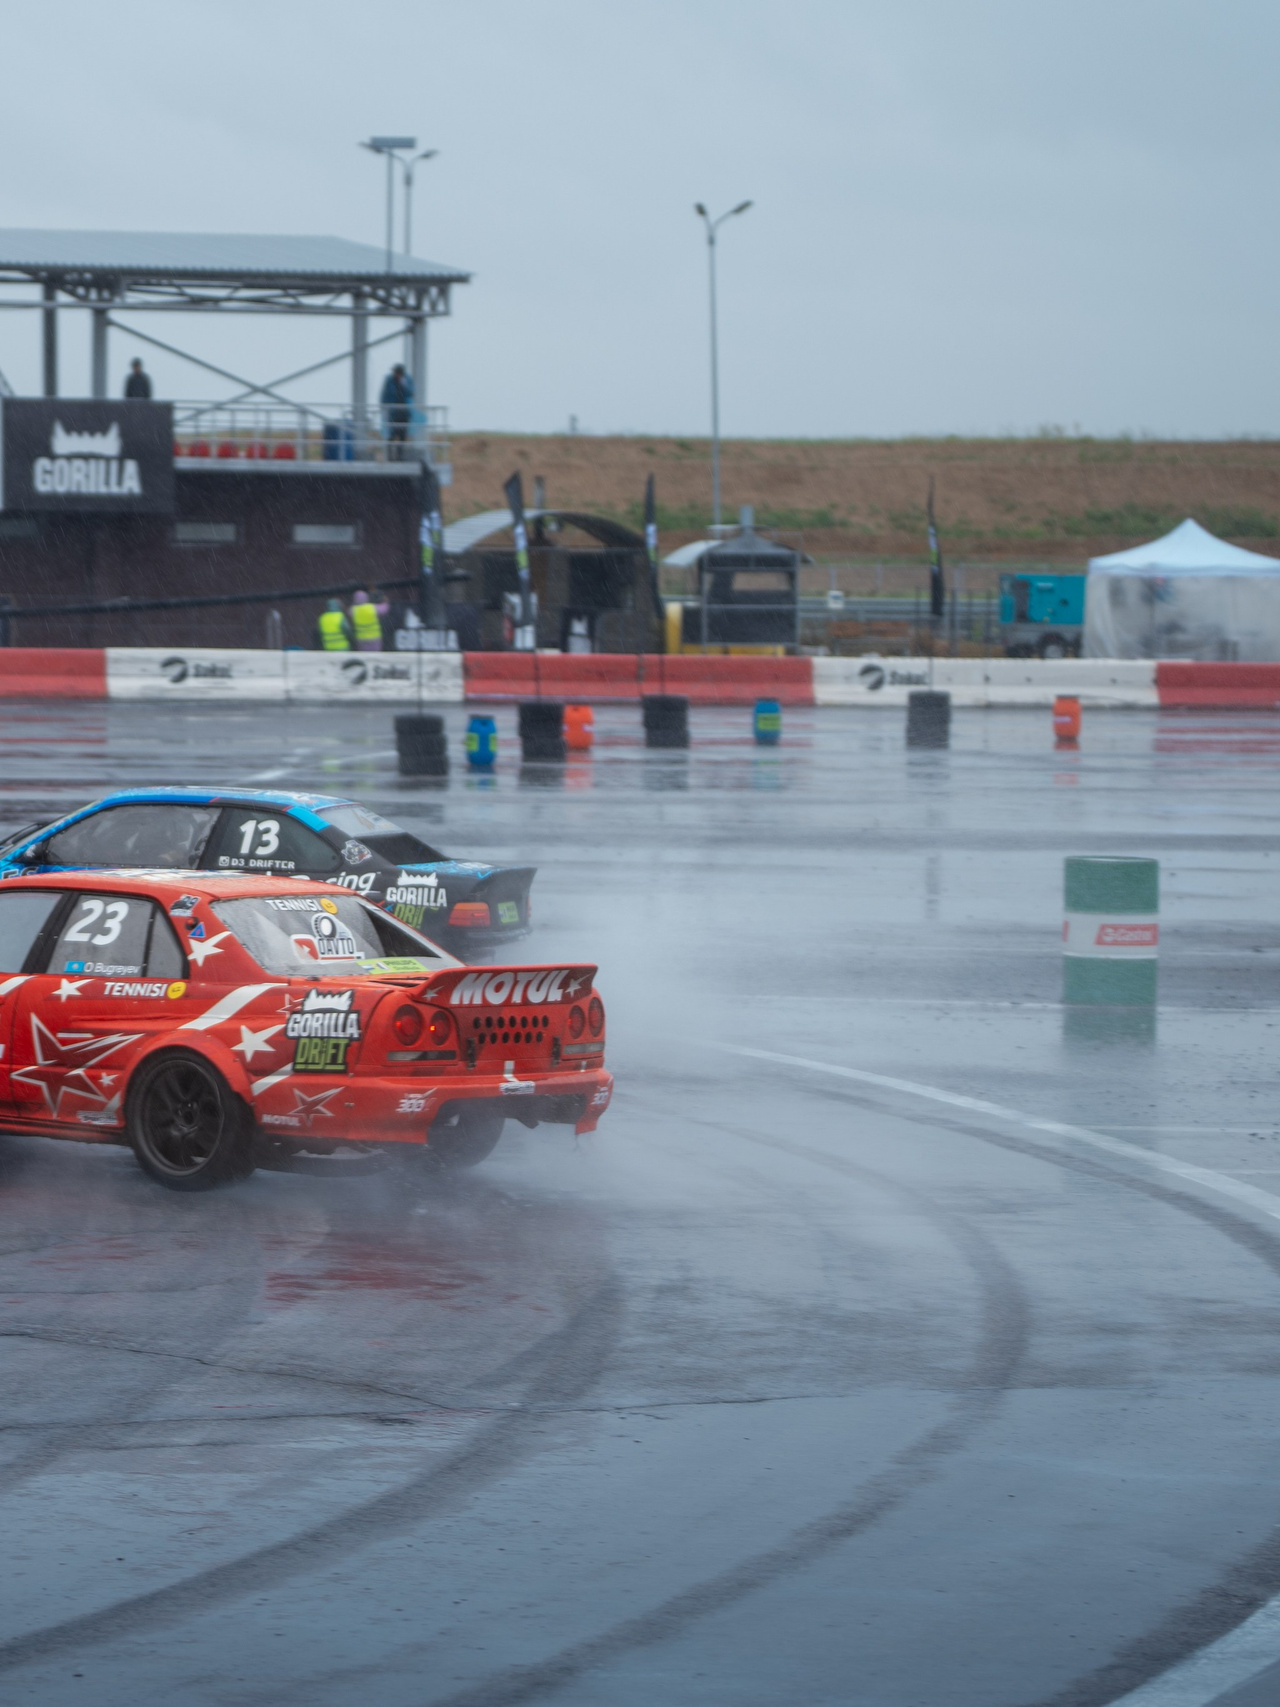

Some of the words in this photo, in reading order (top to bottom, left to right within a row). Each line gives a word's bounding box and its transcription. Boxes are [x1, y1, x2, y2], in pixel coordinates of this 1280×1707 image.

[34, 457, 142, 494] GORILLA
[239, 819, 280, 855] 13
[386, 886, 447, 907] GORILLA
[64, 899, 129, 945] 23
[104, 982, 169, 997] TENNISI
[449, 970, 570, 1005] MOTUL
[288, 1012, 360, 1039] GORILLA
[296, 1038, 349, 1070] DRIFT
[261, 1113, 301, 1127] MOTUL
